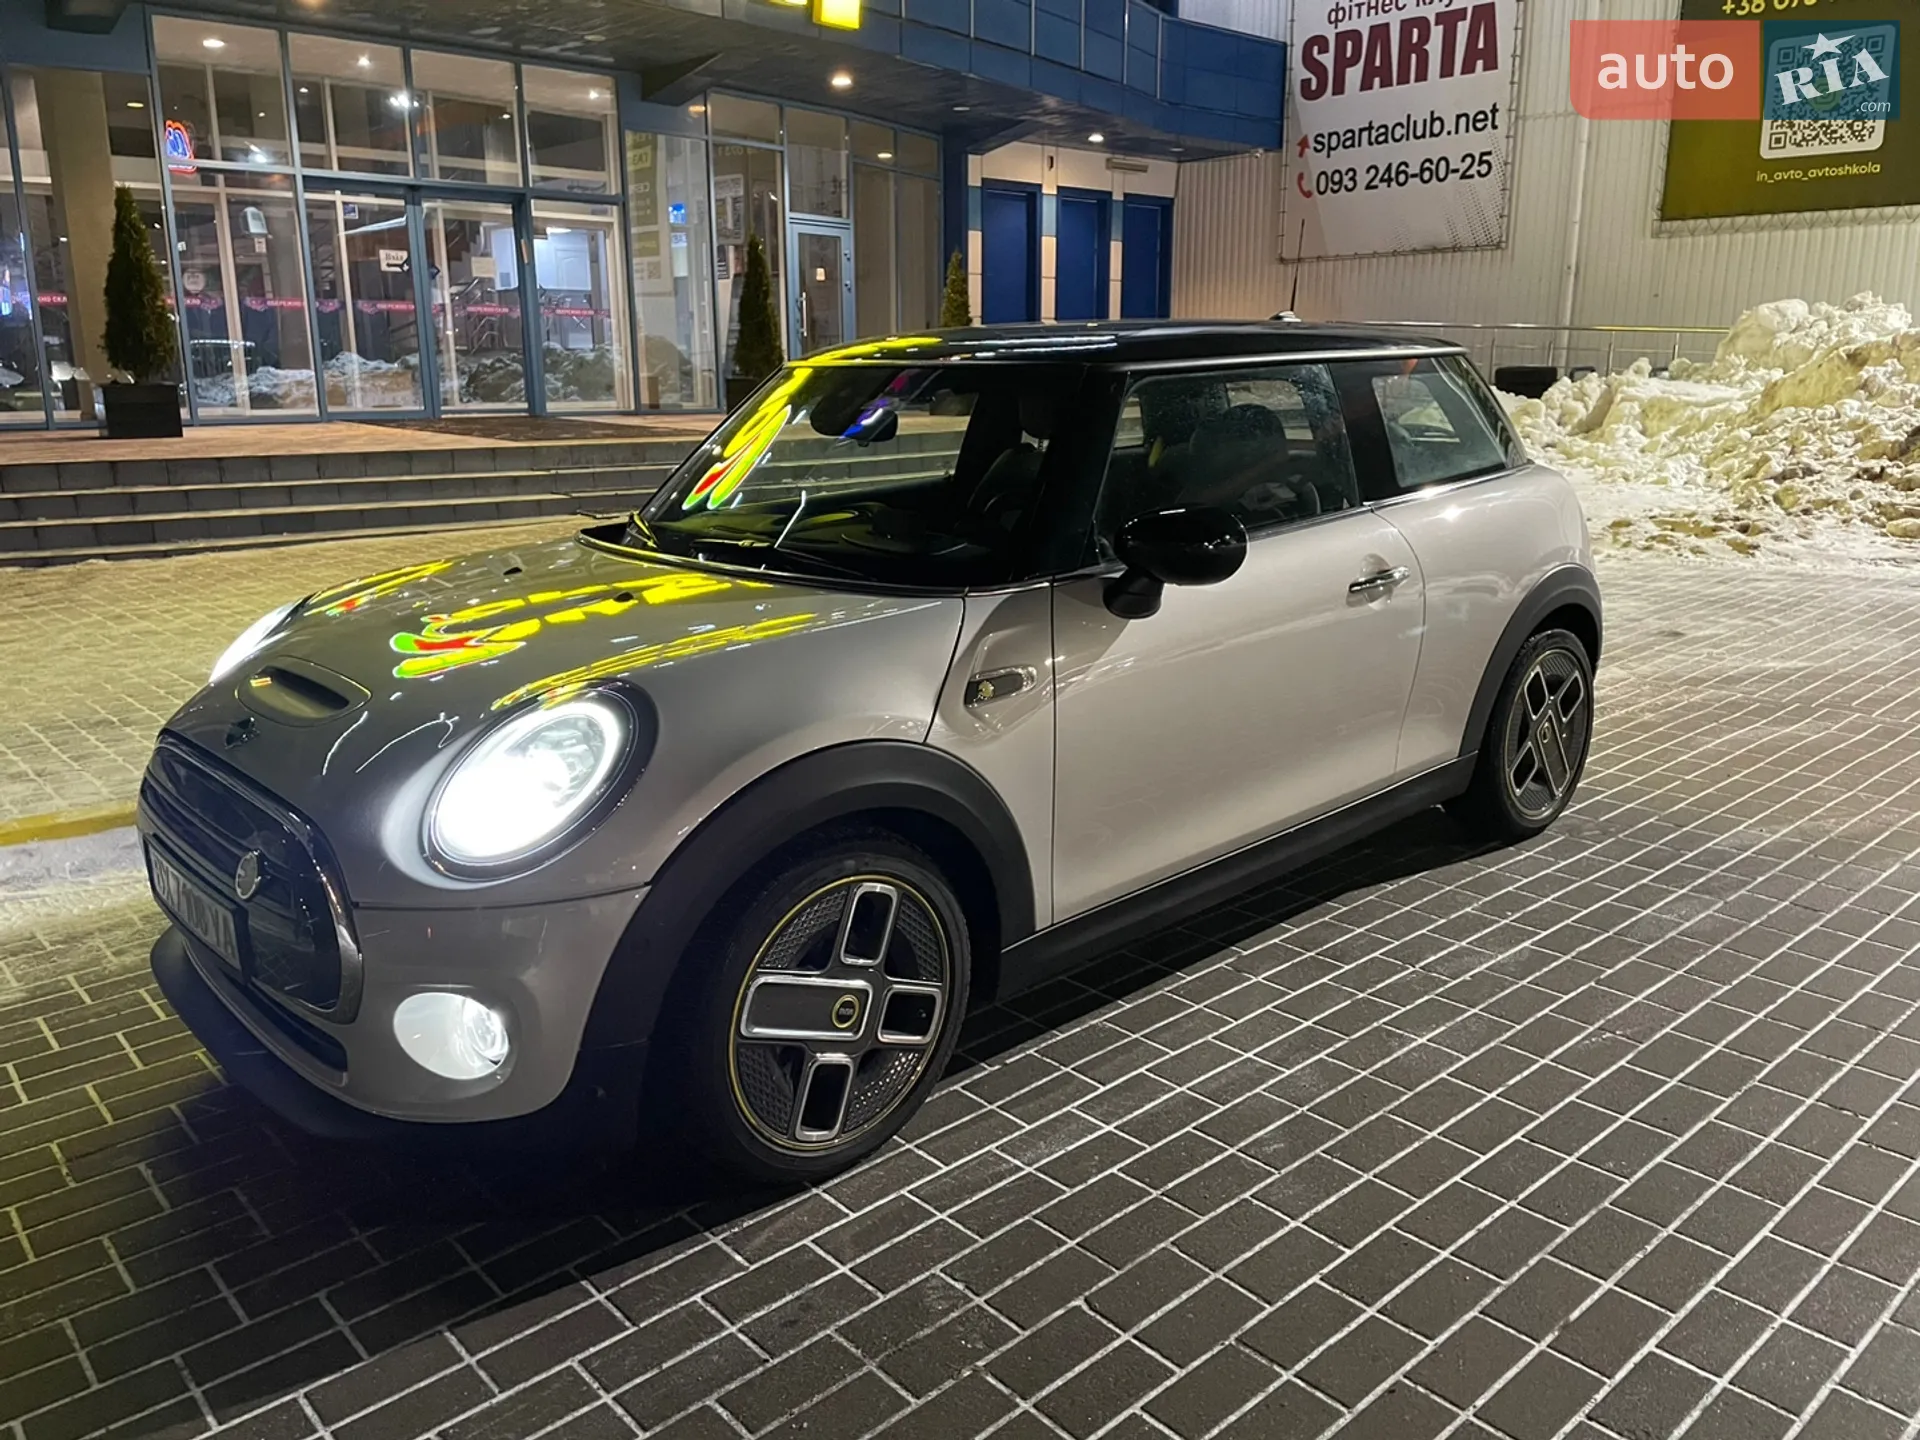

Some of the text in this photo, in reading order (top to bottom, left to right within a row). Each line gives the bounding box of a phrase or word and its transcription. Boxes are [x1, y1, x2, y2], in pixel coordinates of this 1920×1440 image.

[1300, 2, 1499, 101] SPARTA
[1312, 102, 1499, 158] spartaclub.net
[1316, 151, 1493, 196] 093 246-60-25
[1756, 161, 1881, 184] in_avto_avtoshkola
